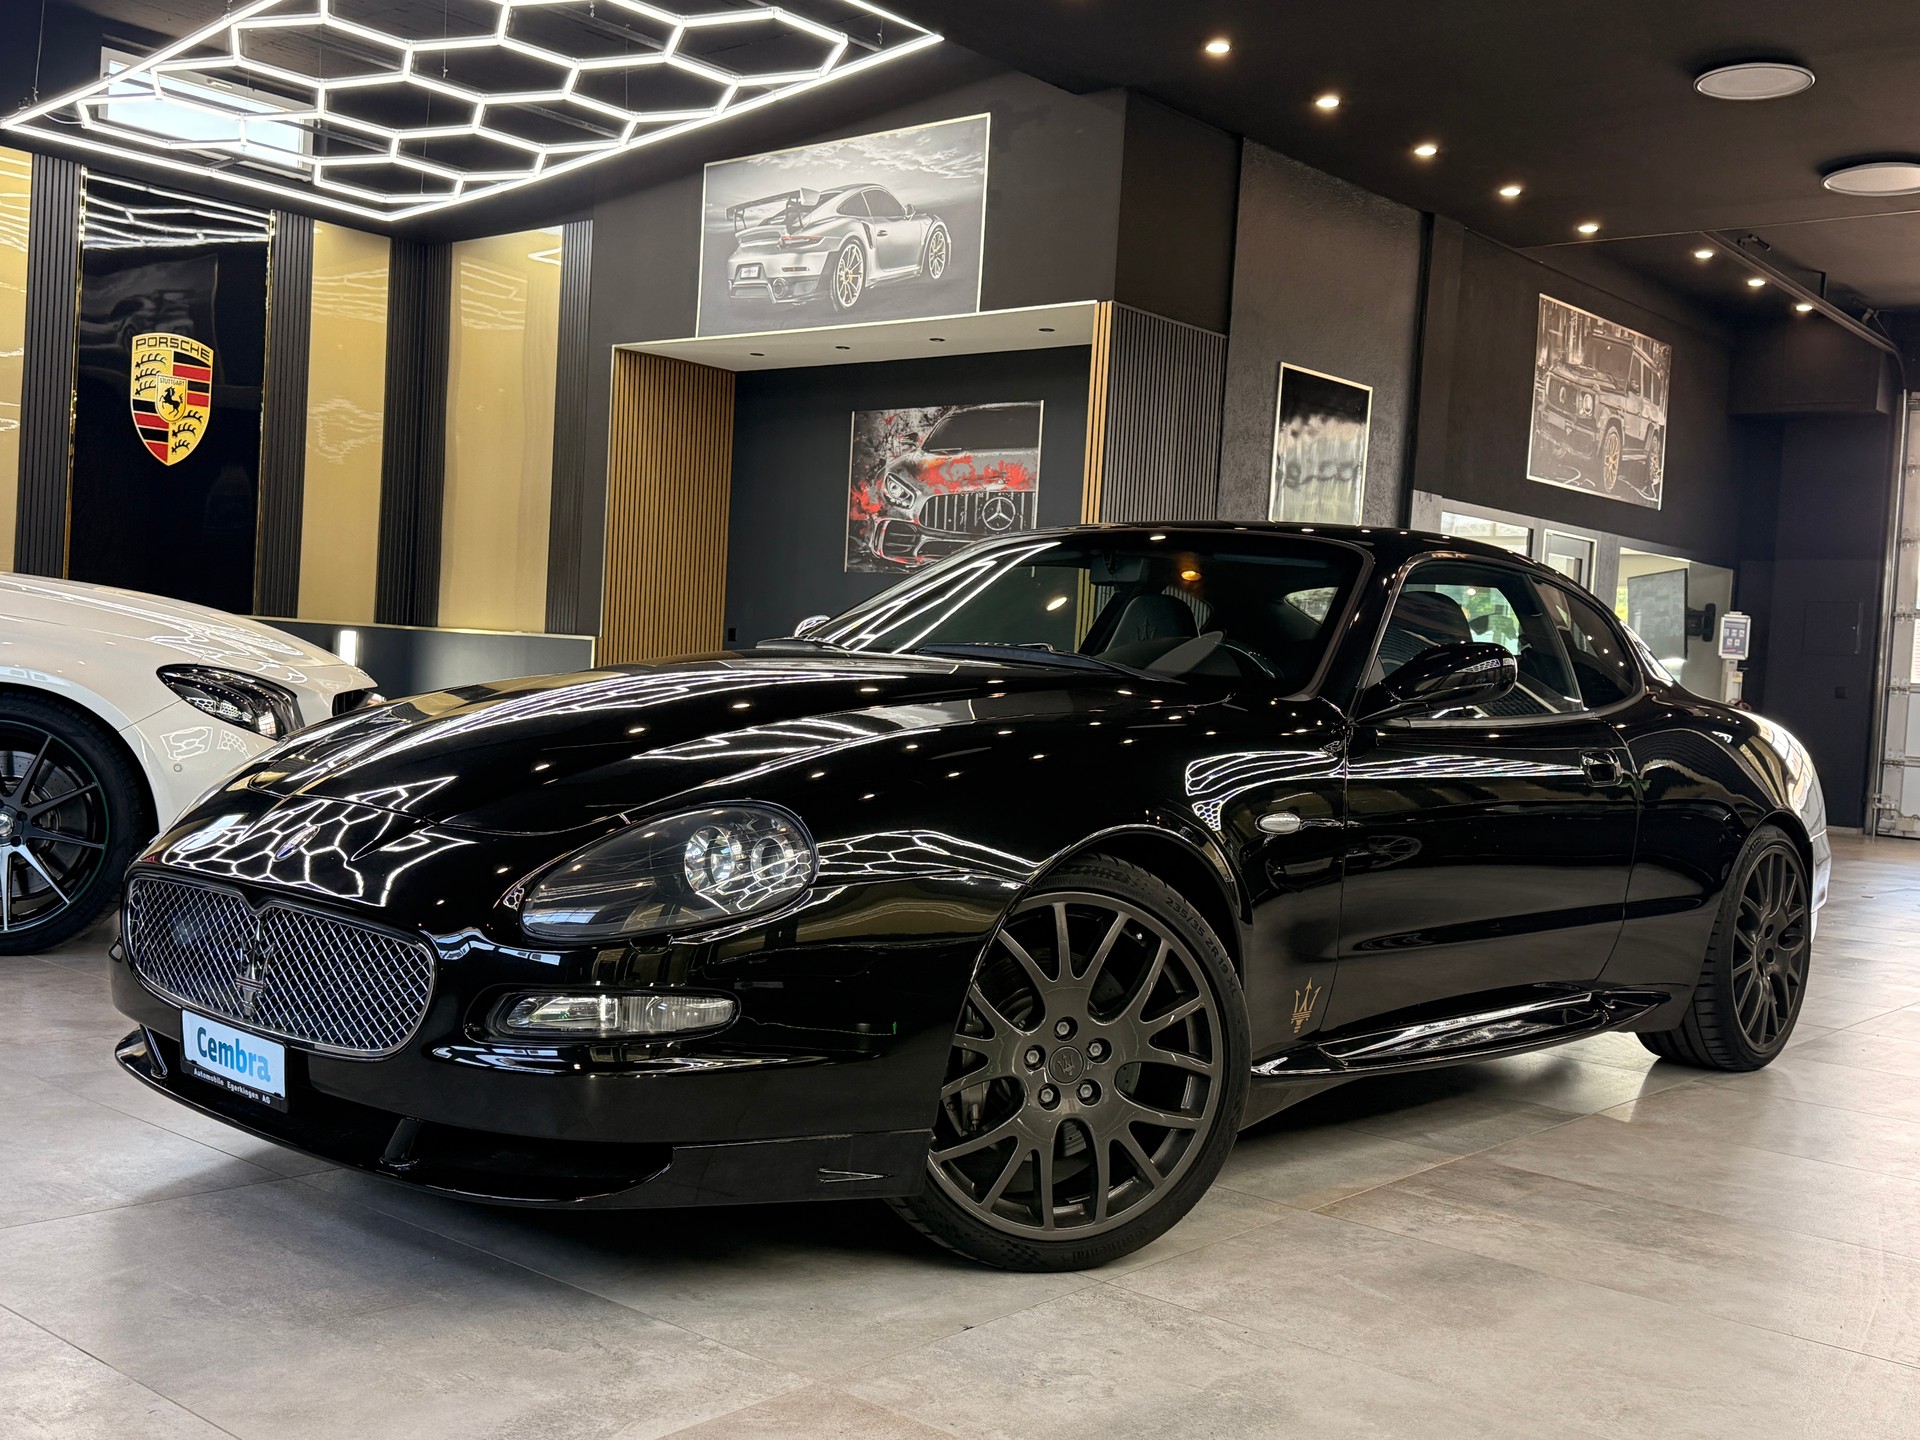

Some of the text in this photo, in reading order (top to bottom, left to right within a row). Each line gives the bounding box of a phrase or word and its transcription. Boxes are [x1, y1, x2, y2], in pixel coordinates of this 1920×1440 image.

[135, 336, 210, 362] PORSCHE
[159, 377, 185, 386] STUTTGART
[1165, 896, 1206, 937] 235/35
[196, 1026, 271, 1082] Cembra
[193, 1067, 271, 1104] Automobile Egerkingen AG
